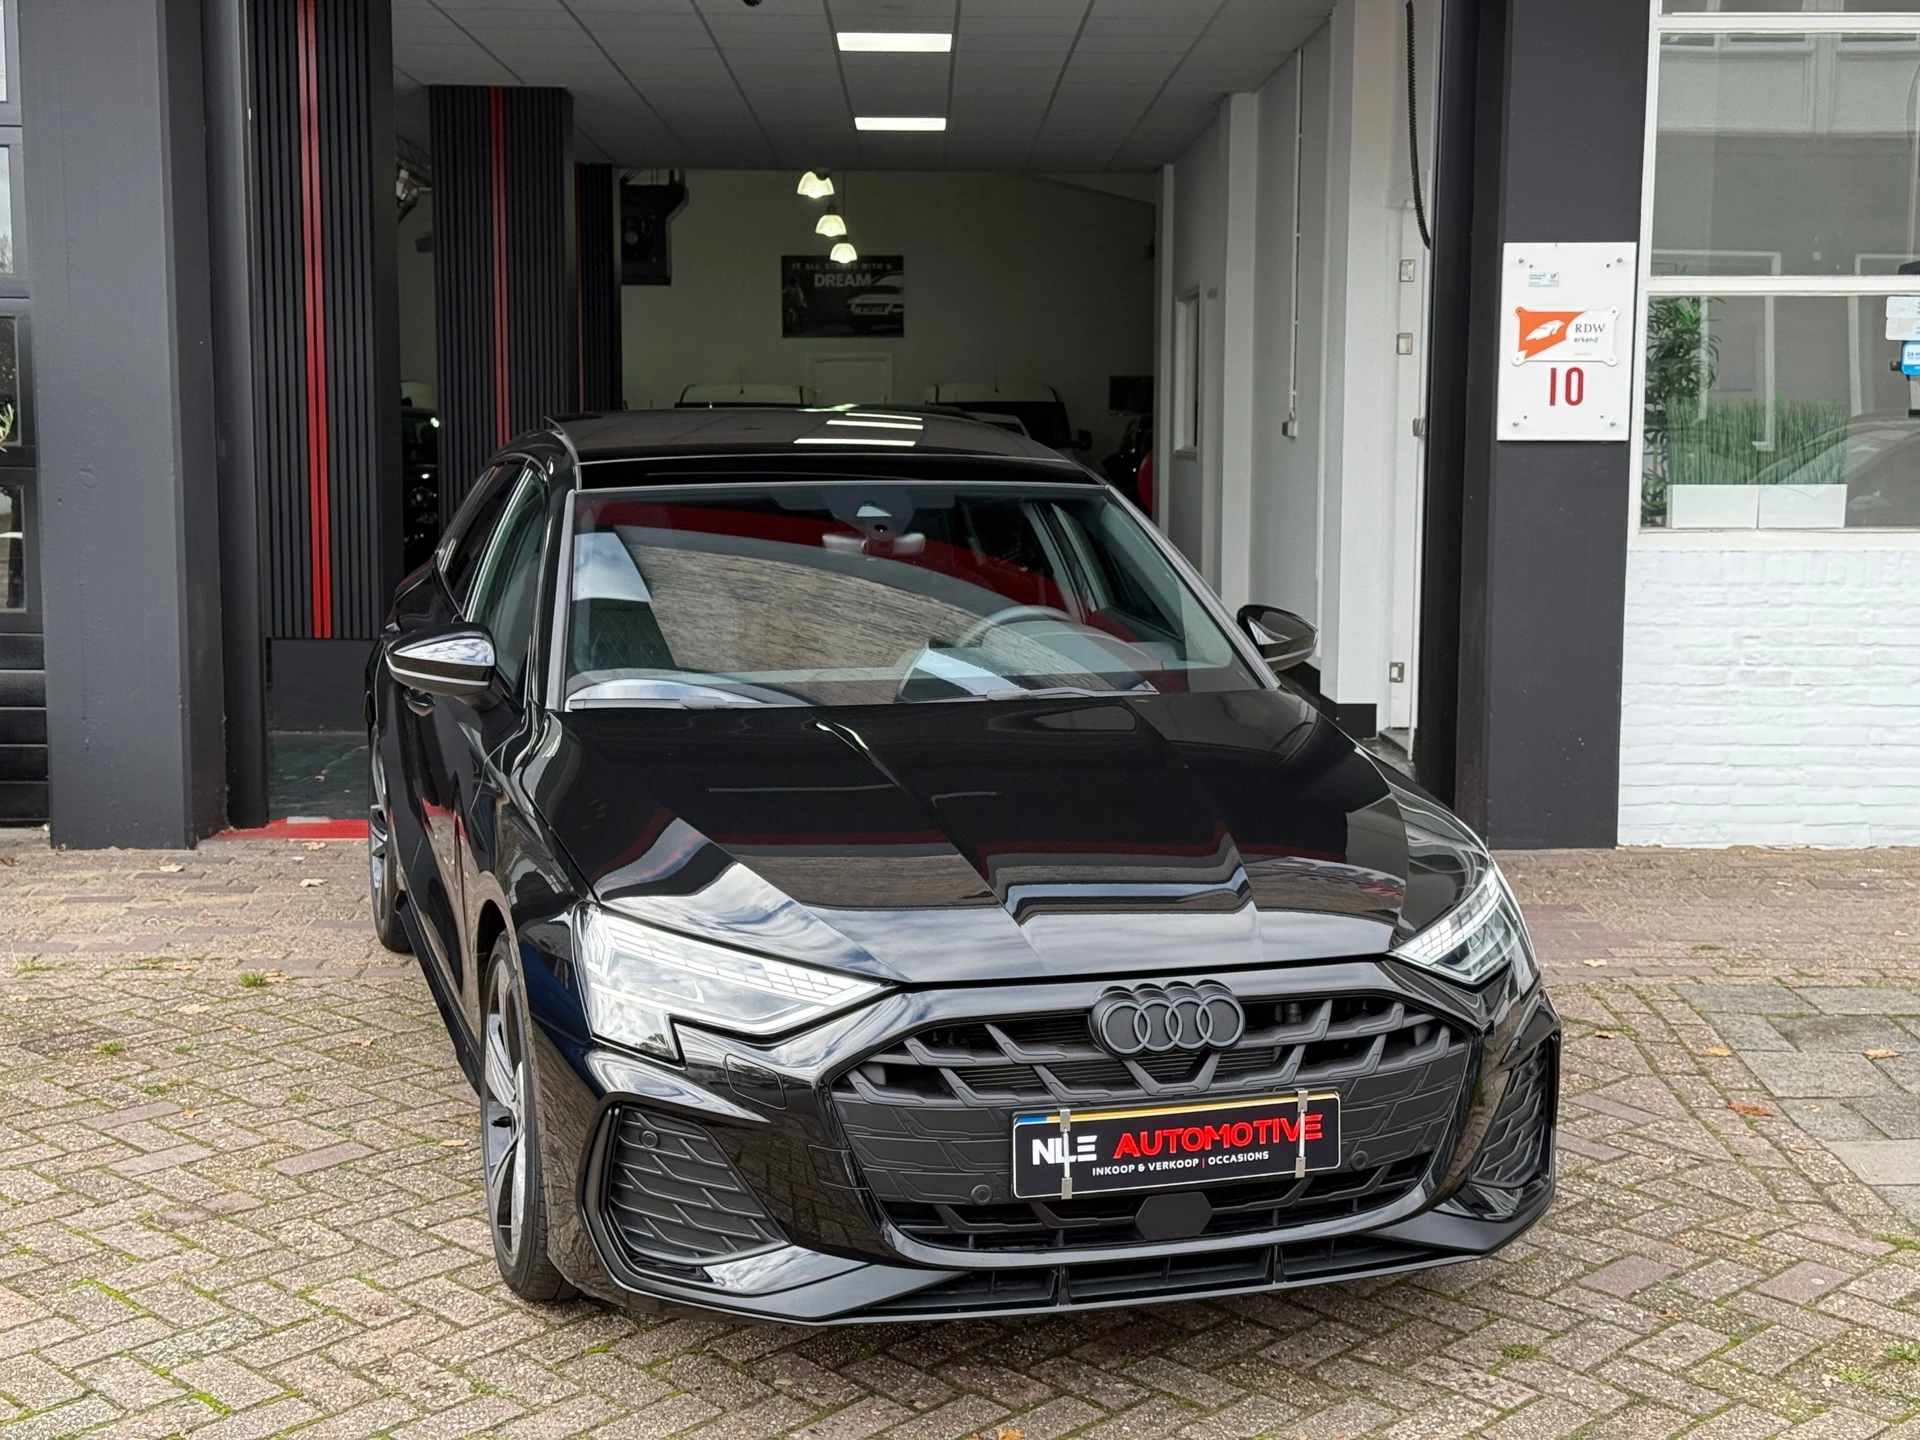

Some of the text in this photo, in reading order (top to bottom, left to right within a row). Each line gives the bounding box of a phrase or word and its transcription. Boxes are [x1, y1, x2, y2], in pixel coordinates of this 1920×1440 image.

[814, 273, 872, 288] DREAM
[1575, 323, 1606, 333] RDW
[1549, 367, 1584, 406] 10
[1031, 1113, 1324, 1166] NLE AUTOMOTIVE
[1091, 1164, 1136, 1176] INKOOP
[1138, 1163, 1146, 1173] &
[1147, 1157, 1200, 1172] VERKOOP
[1207, 1151, 1269, 1168] OCCASIONS
